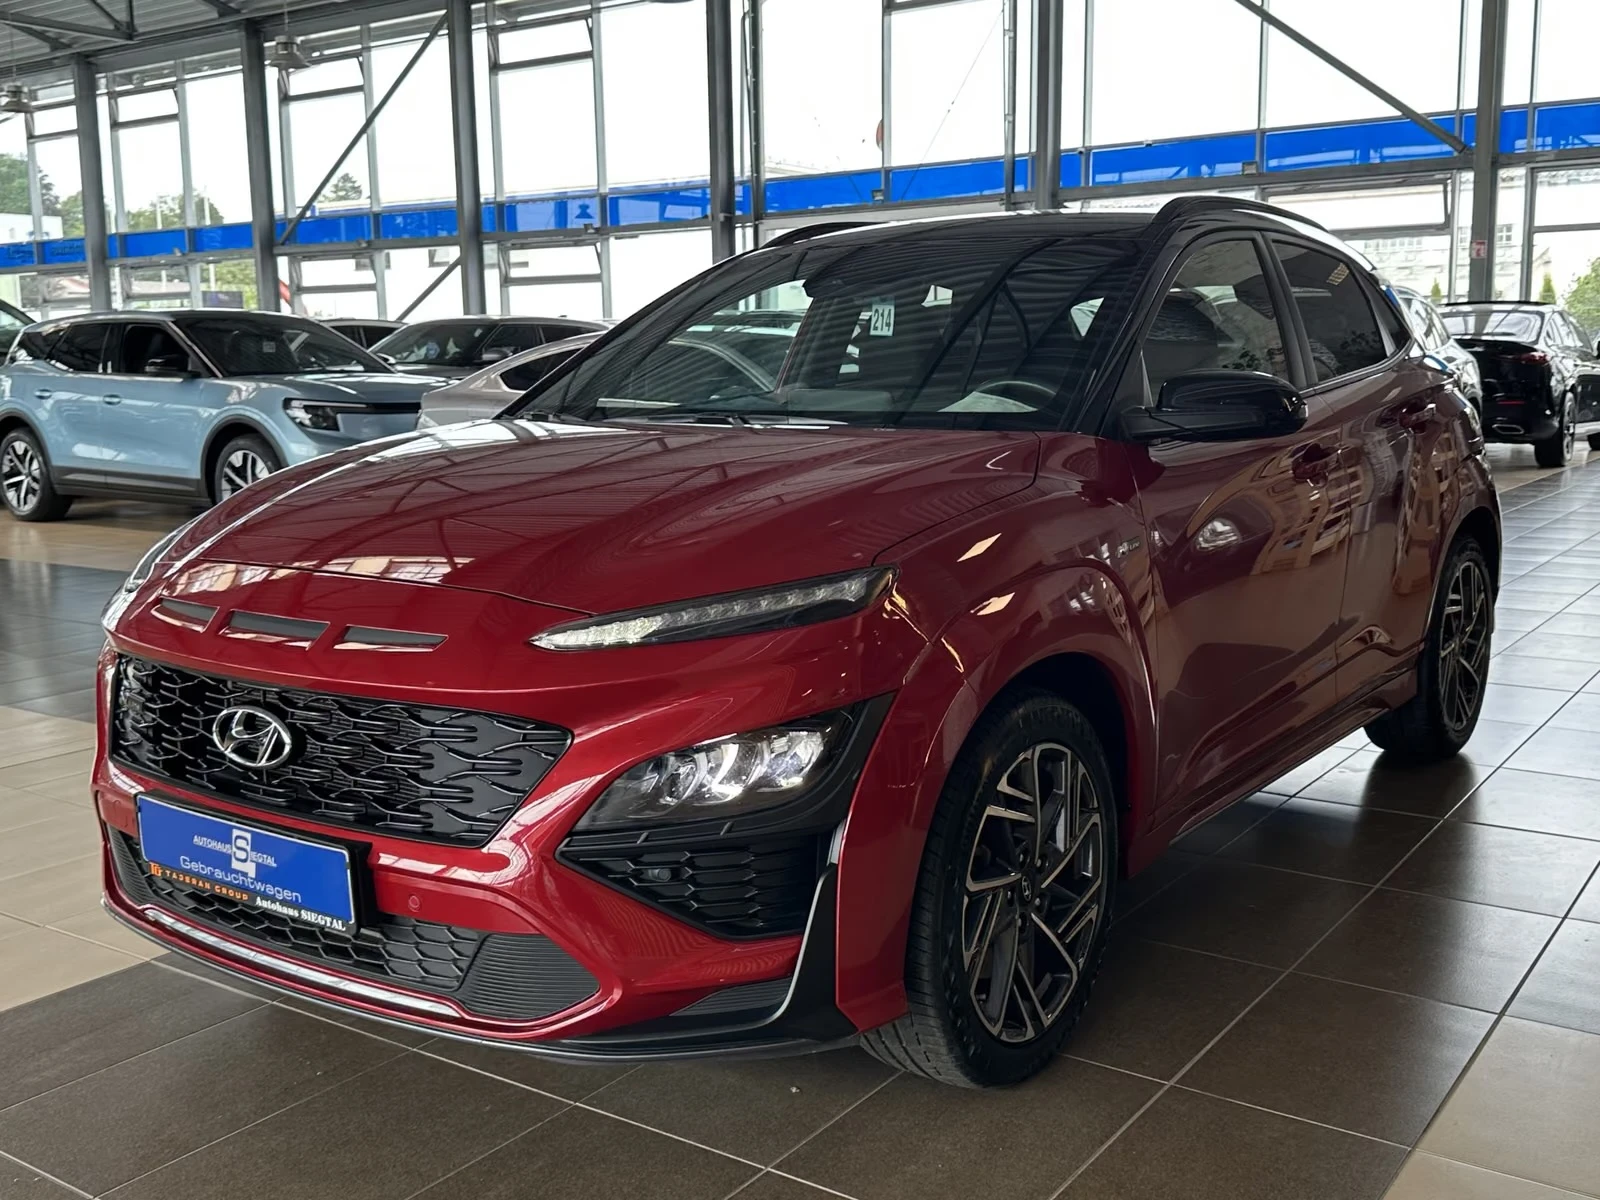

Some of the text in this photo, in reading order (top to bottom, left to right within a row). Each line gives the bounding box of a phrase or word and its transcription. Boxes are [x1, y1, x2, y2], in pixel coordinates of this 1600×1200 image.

[872, 308, 892, 332] 214
[192, 834, 232, 855] AUTOHAUS
[180, 856, 302, 904] Gebrauchtwagen
[214, 885, 249, 901] GROUP
[255, 896, 346, 931] Autohaus SIEGTAL
